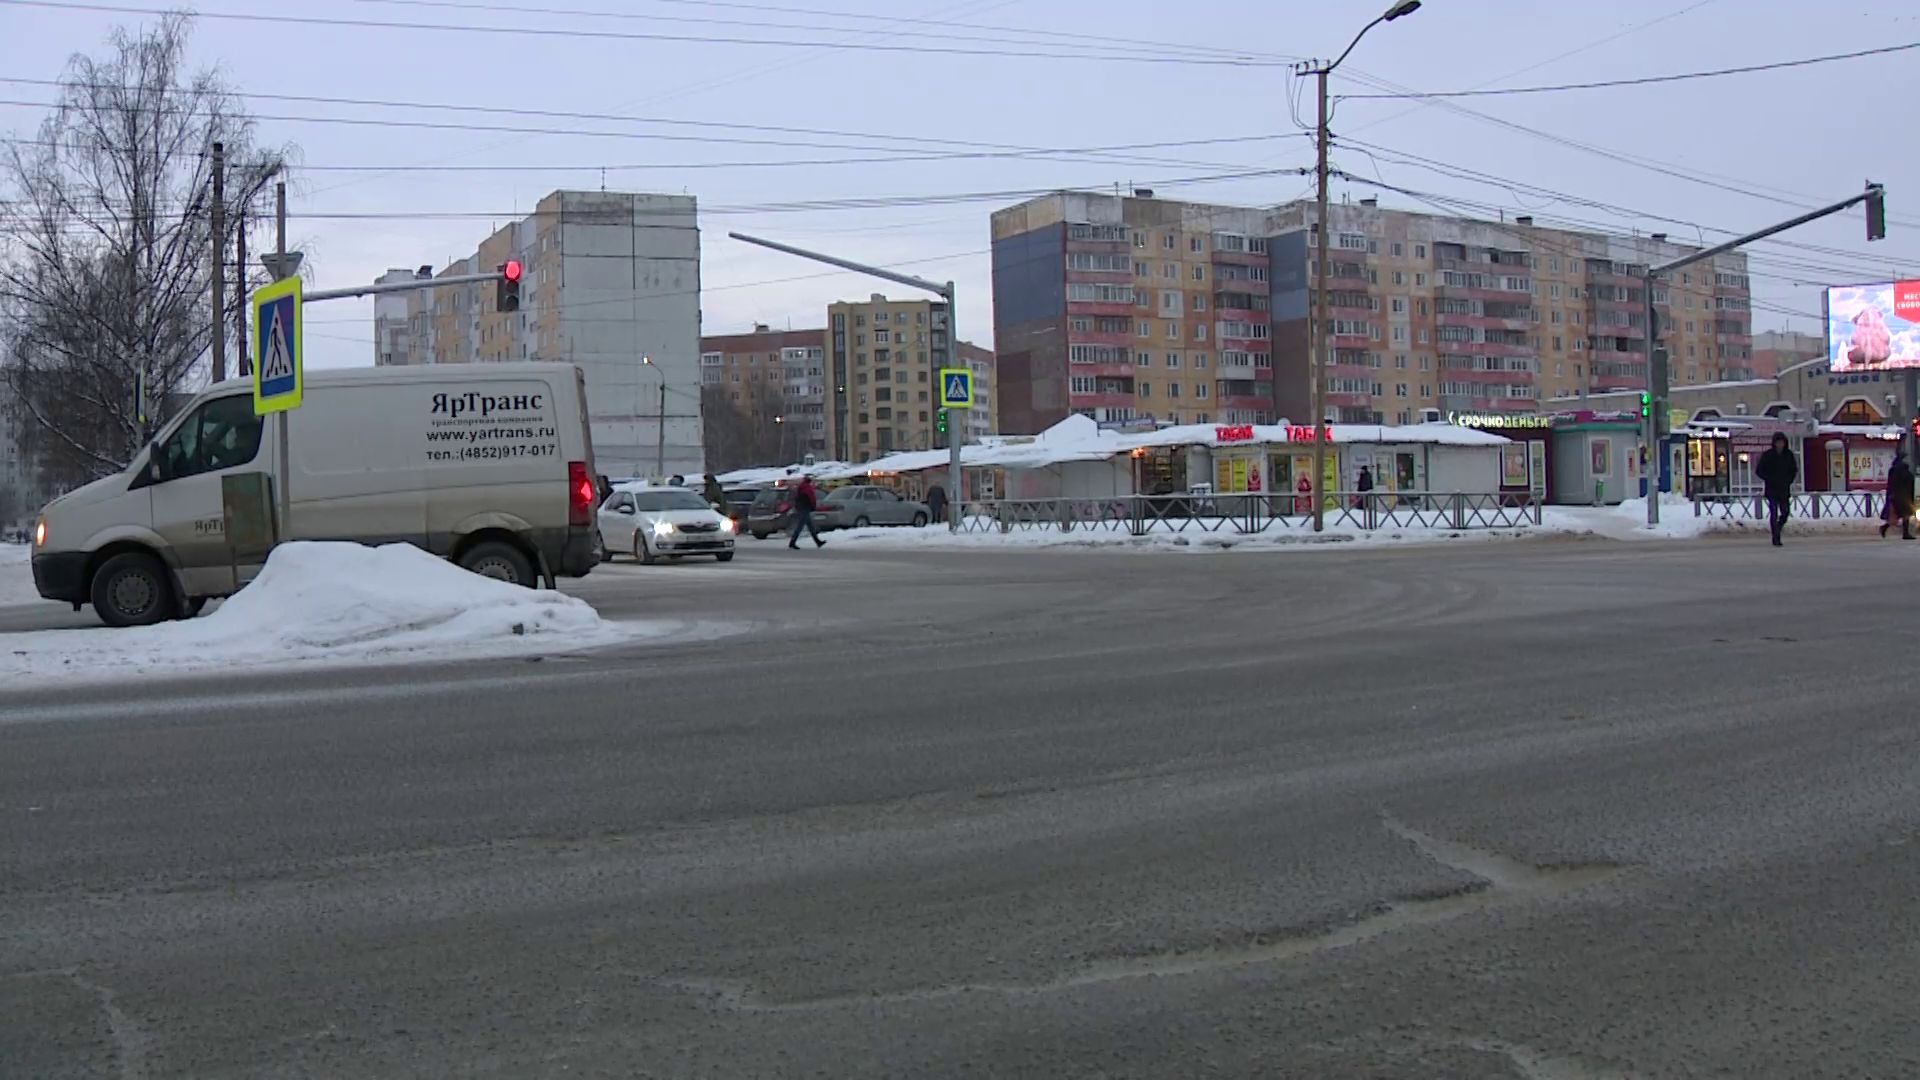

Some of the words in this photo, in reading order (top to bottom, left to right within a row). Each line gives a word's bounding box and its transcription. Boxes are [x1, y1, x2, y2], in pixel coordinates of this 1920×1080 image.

[431, 392, 543, 417] ЯрТранс
[426, 427, 555, 443] www.yartrans.ru
[1215, 424, 1253, 441] ТАБАК
[1284, 425, 1333, 442] ТАБК
